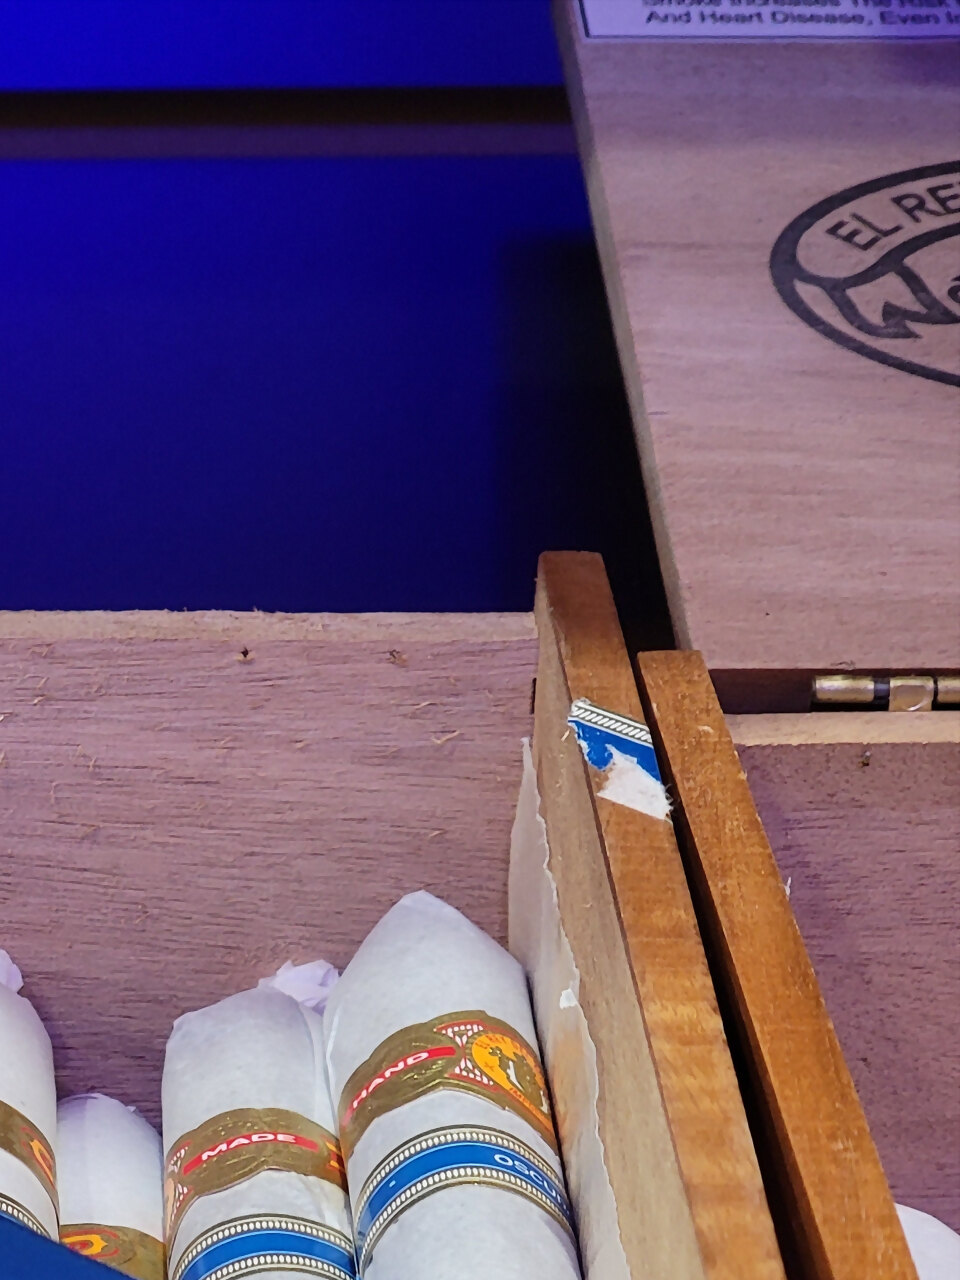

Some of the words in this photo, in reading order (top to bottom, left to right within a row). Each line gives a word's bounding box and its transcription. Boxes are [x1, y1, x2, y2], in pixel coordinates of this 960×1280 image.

[645, 10, 692, 24] And
[699, 10, 764, 24] Heart
[879, 10, 940, 25] Even
[825, 212, 904, 251] EL
[891, 182, 960, 223] RE
[352, 1051, 430, 1109] HAND
[201, 1132, 297, 1161] MADE
